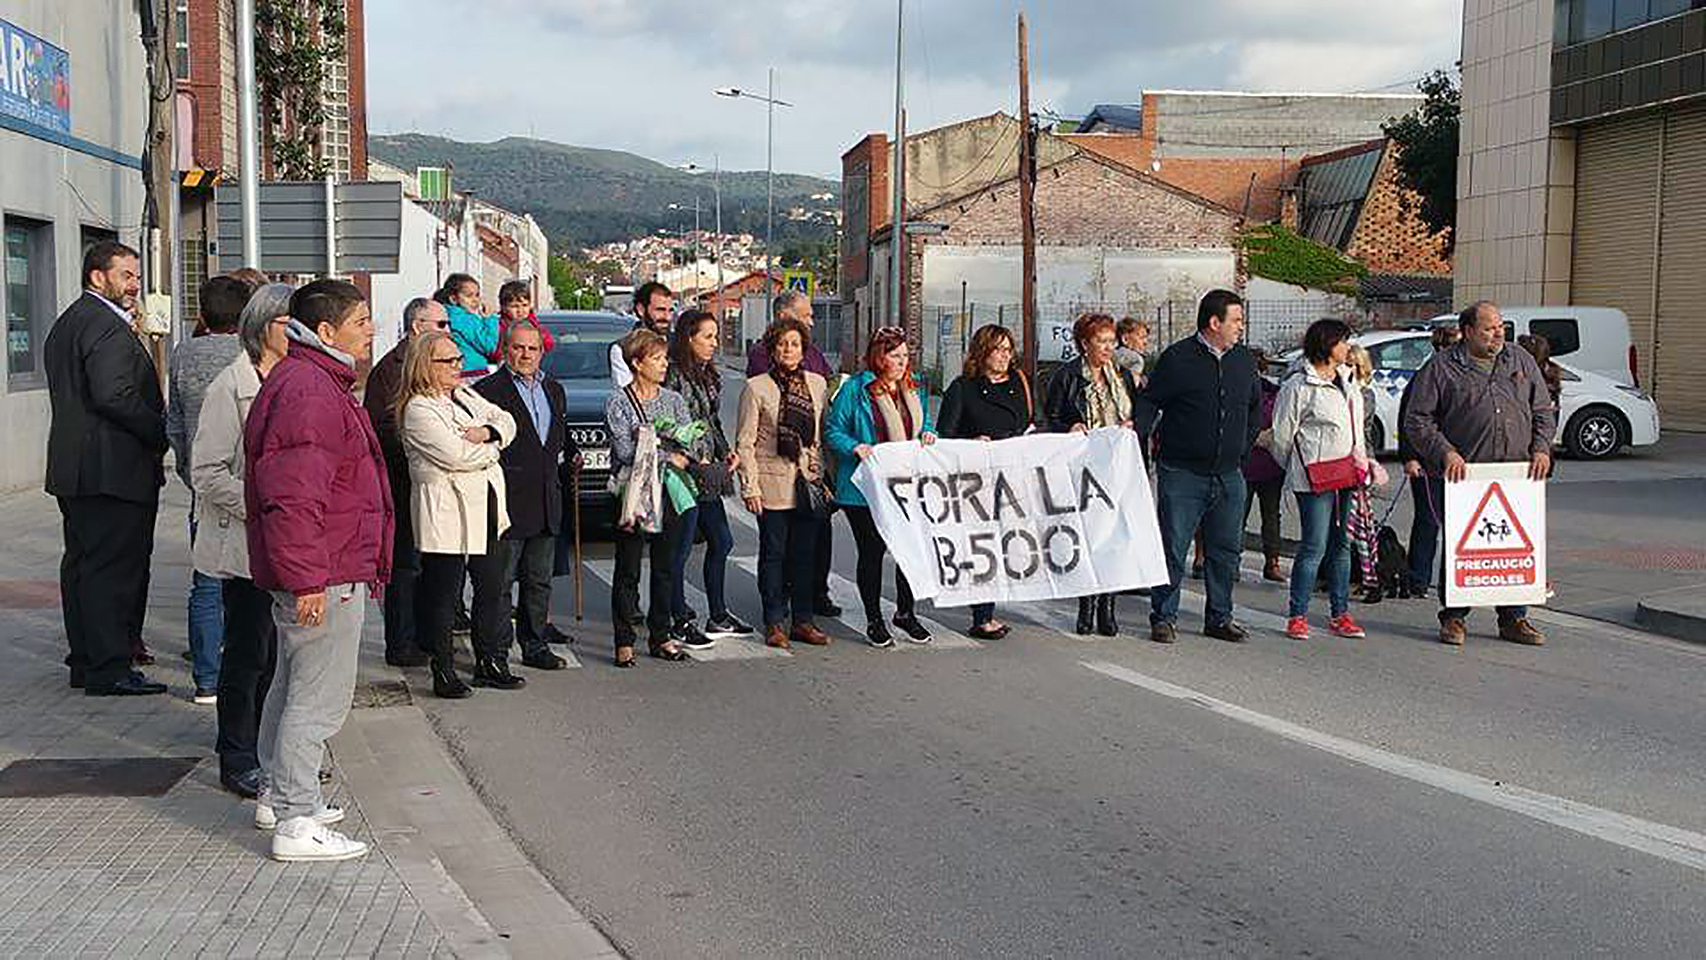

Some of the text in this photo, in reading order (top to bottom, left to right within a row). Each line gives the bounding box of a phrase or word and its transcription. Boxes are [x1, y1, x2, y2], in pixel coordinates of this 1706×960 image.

[1052, 326, 1074, 342] FO
[886, 466, 1115, 523] FORA LA
[932, 524, 1081, 587] B-500
[1456, 556, 1534, 569] PRECAUCIÓ
[1464, 574, 1525, 586] ESCOLES
